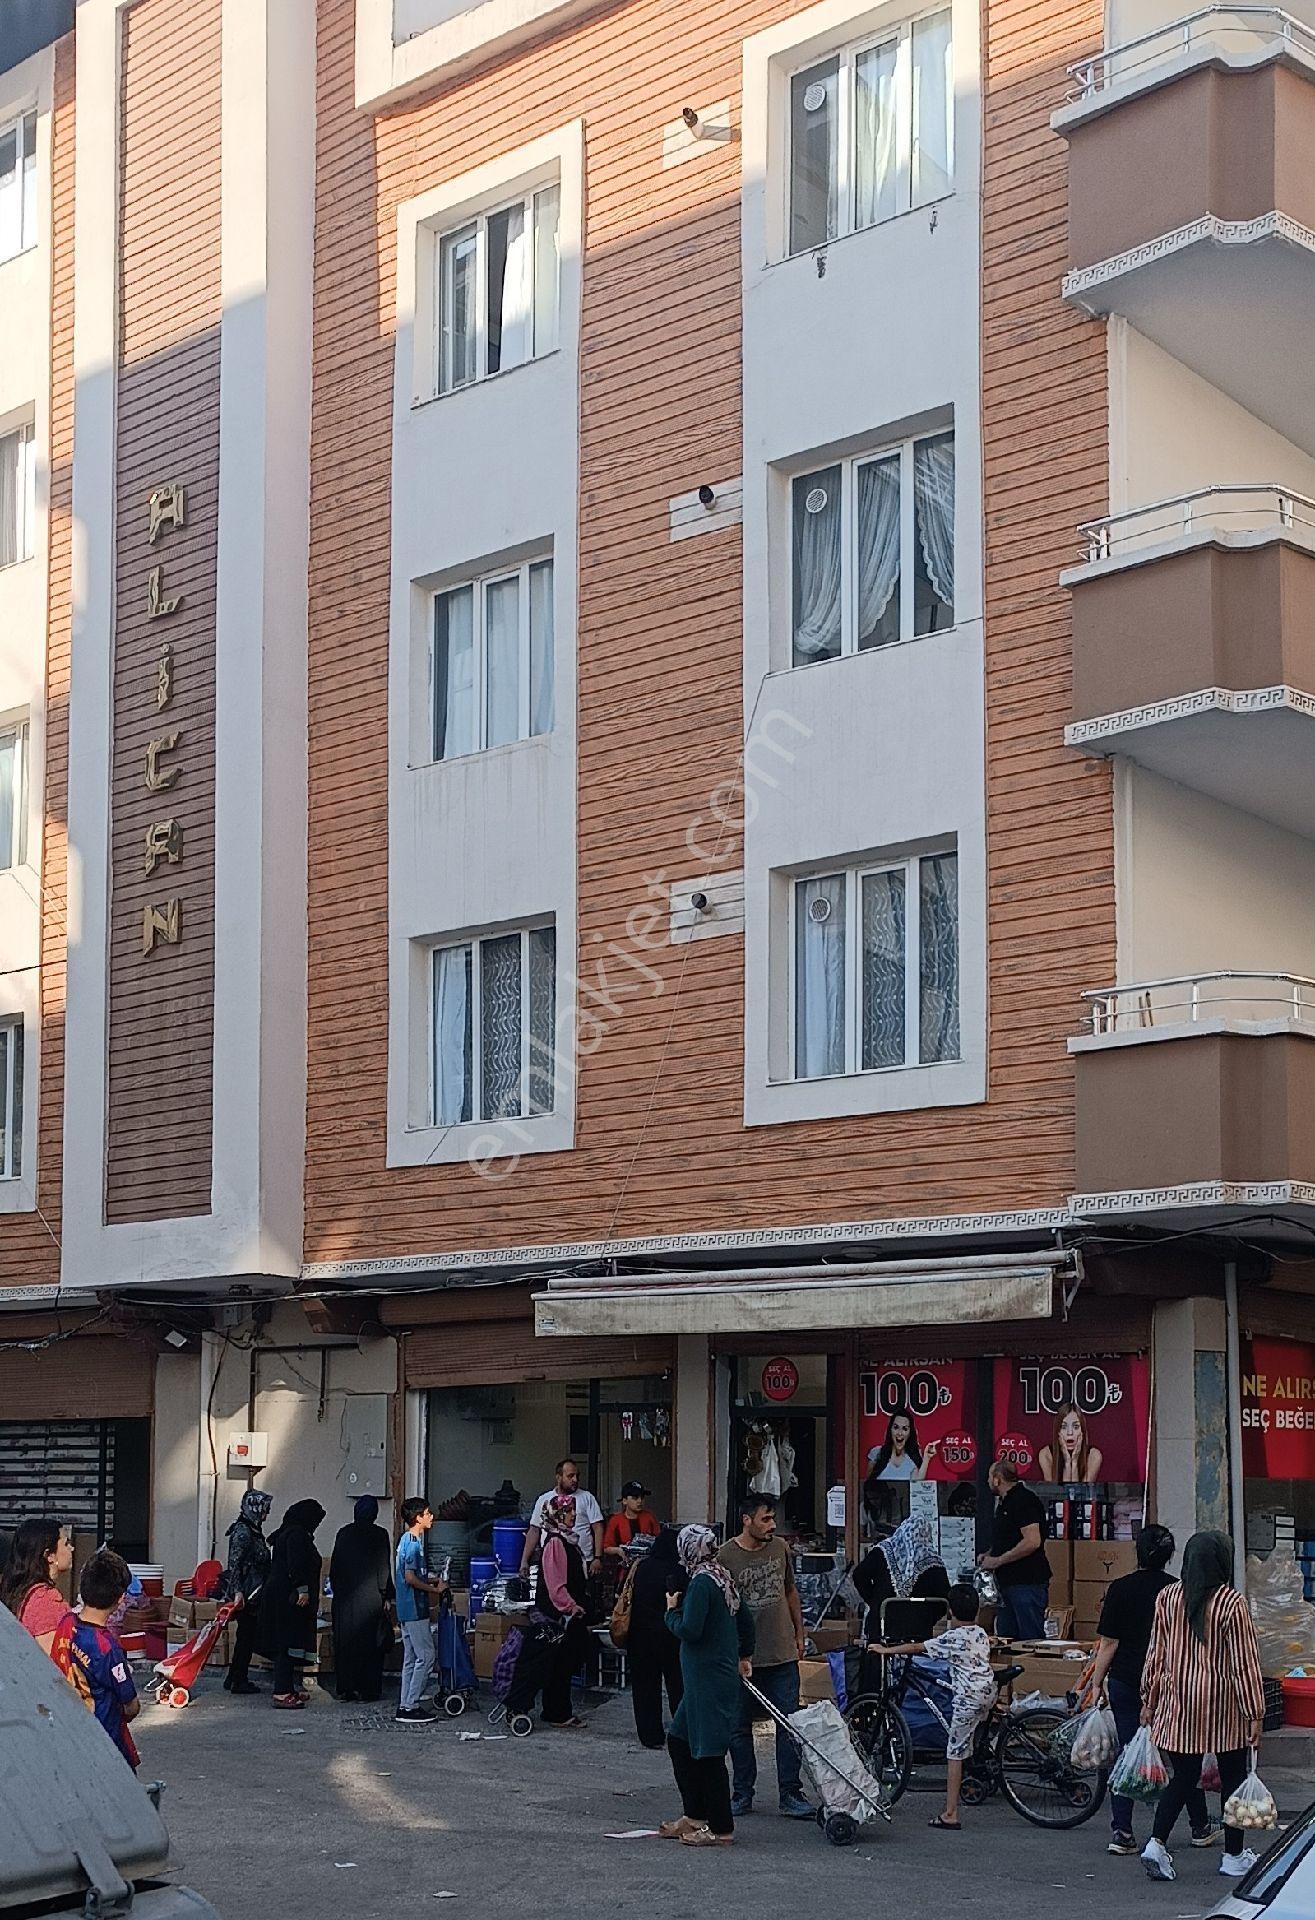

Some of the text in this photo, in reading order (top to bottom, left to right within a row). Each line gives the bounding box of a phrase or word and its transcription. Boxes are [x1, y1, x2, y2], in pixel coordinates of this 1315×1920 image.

[1242, 1374, 1315, 1399] NE ALIR
[1242, 1406, 1315, 1433] SEÇ BEĞE
